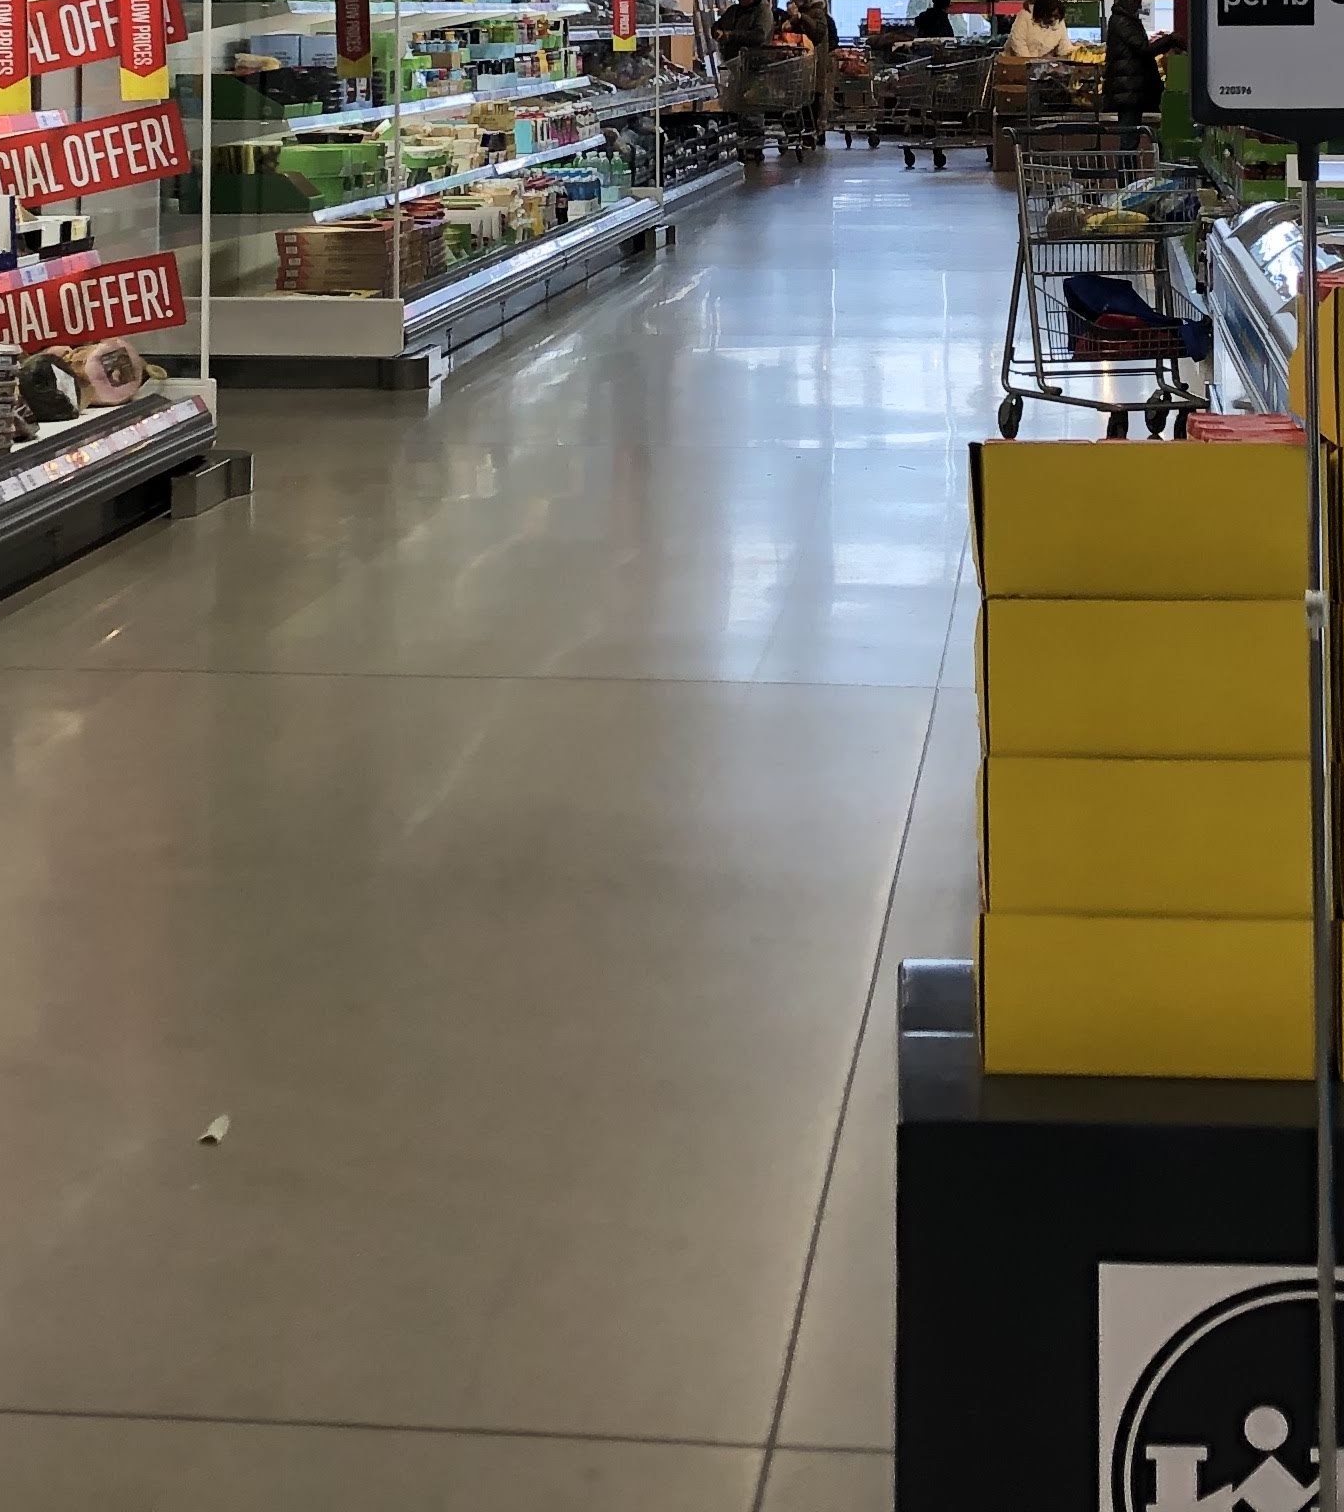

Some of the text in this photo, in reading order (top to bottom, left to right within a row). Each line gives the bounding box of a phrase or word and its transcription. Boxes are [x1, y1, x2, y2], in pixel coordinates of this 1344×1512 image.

[132, 26, 153, 69] PRICES.
[63, 113, 178, 187] OFFER!
[59, 267, 174, 336] OFFER!
